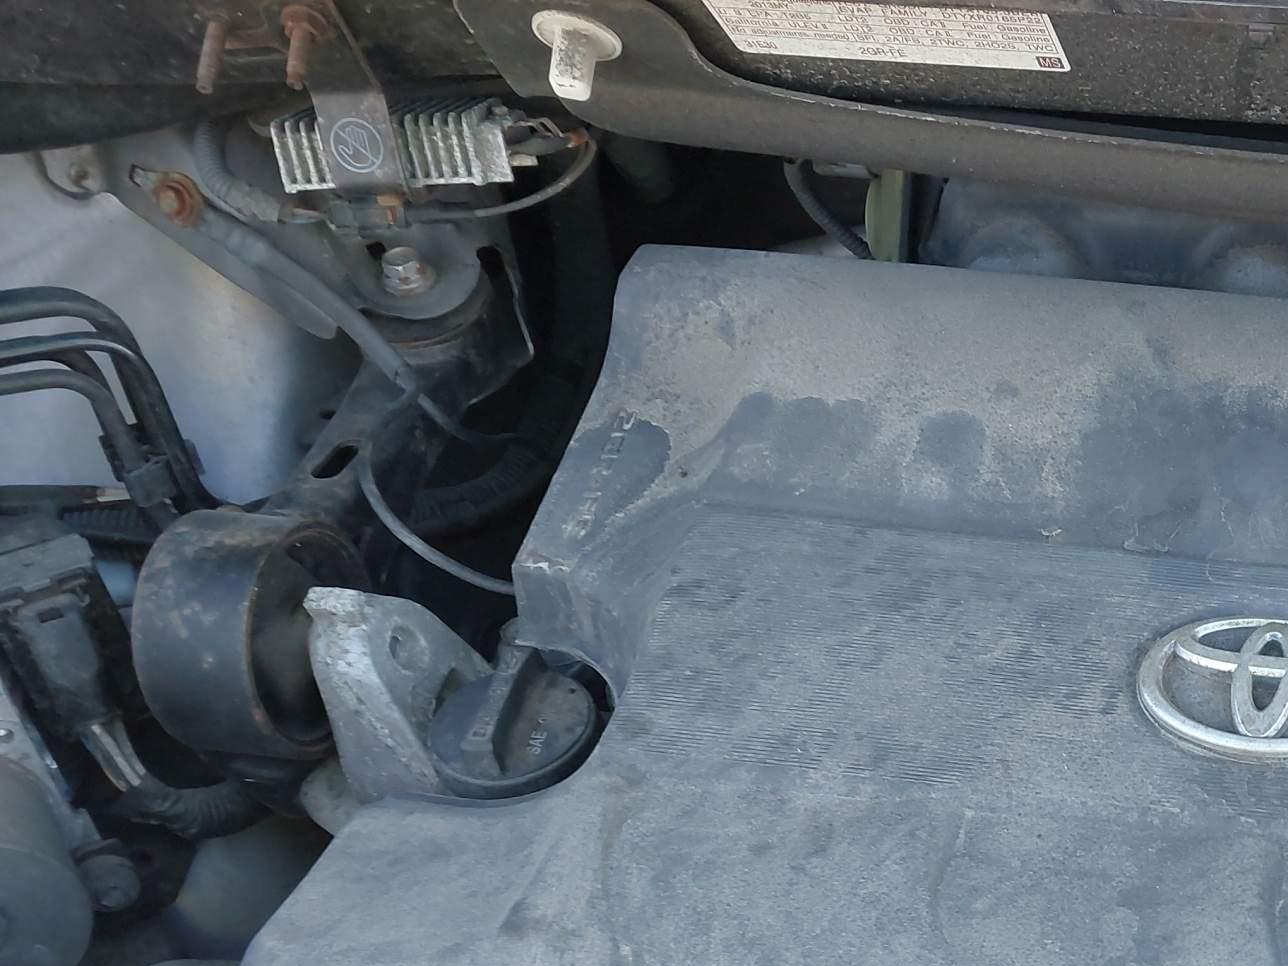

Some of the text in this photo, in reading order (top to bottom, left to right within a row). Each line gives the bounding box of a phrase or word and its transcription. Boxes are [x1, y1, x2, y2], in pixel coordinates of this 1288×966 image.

[838, 6, 873, 17] EVAP
[881, 8, 928, 18] FAMILY
[1039, 57, 1062, 68] MS
[527, 729, 548, 755] SAE
